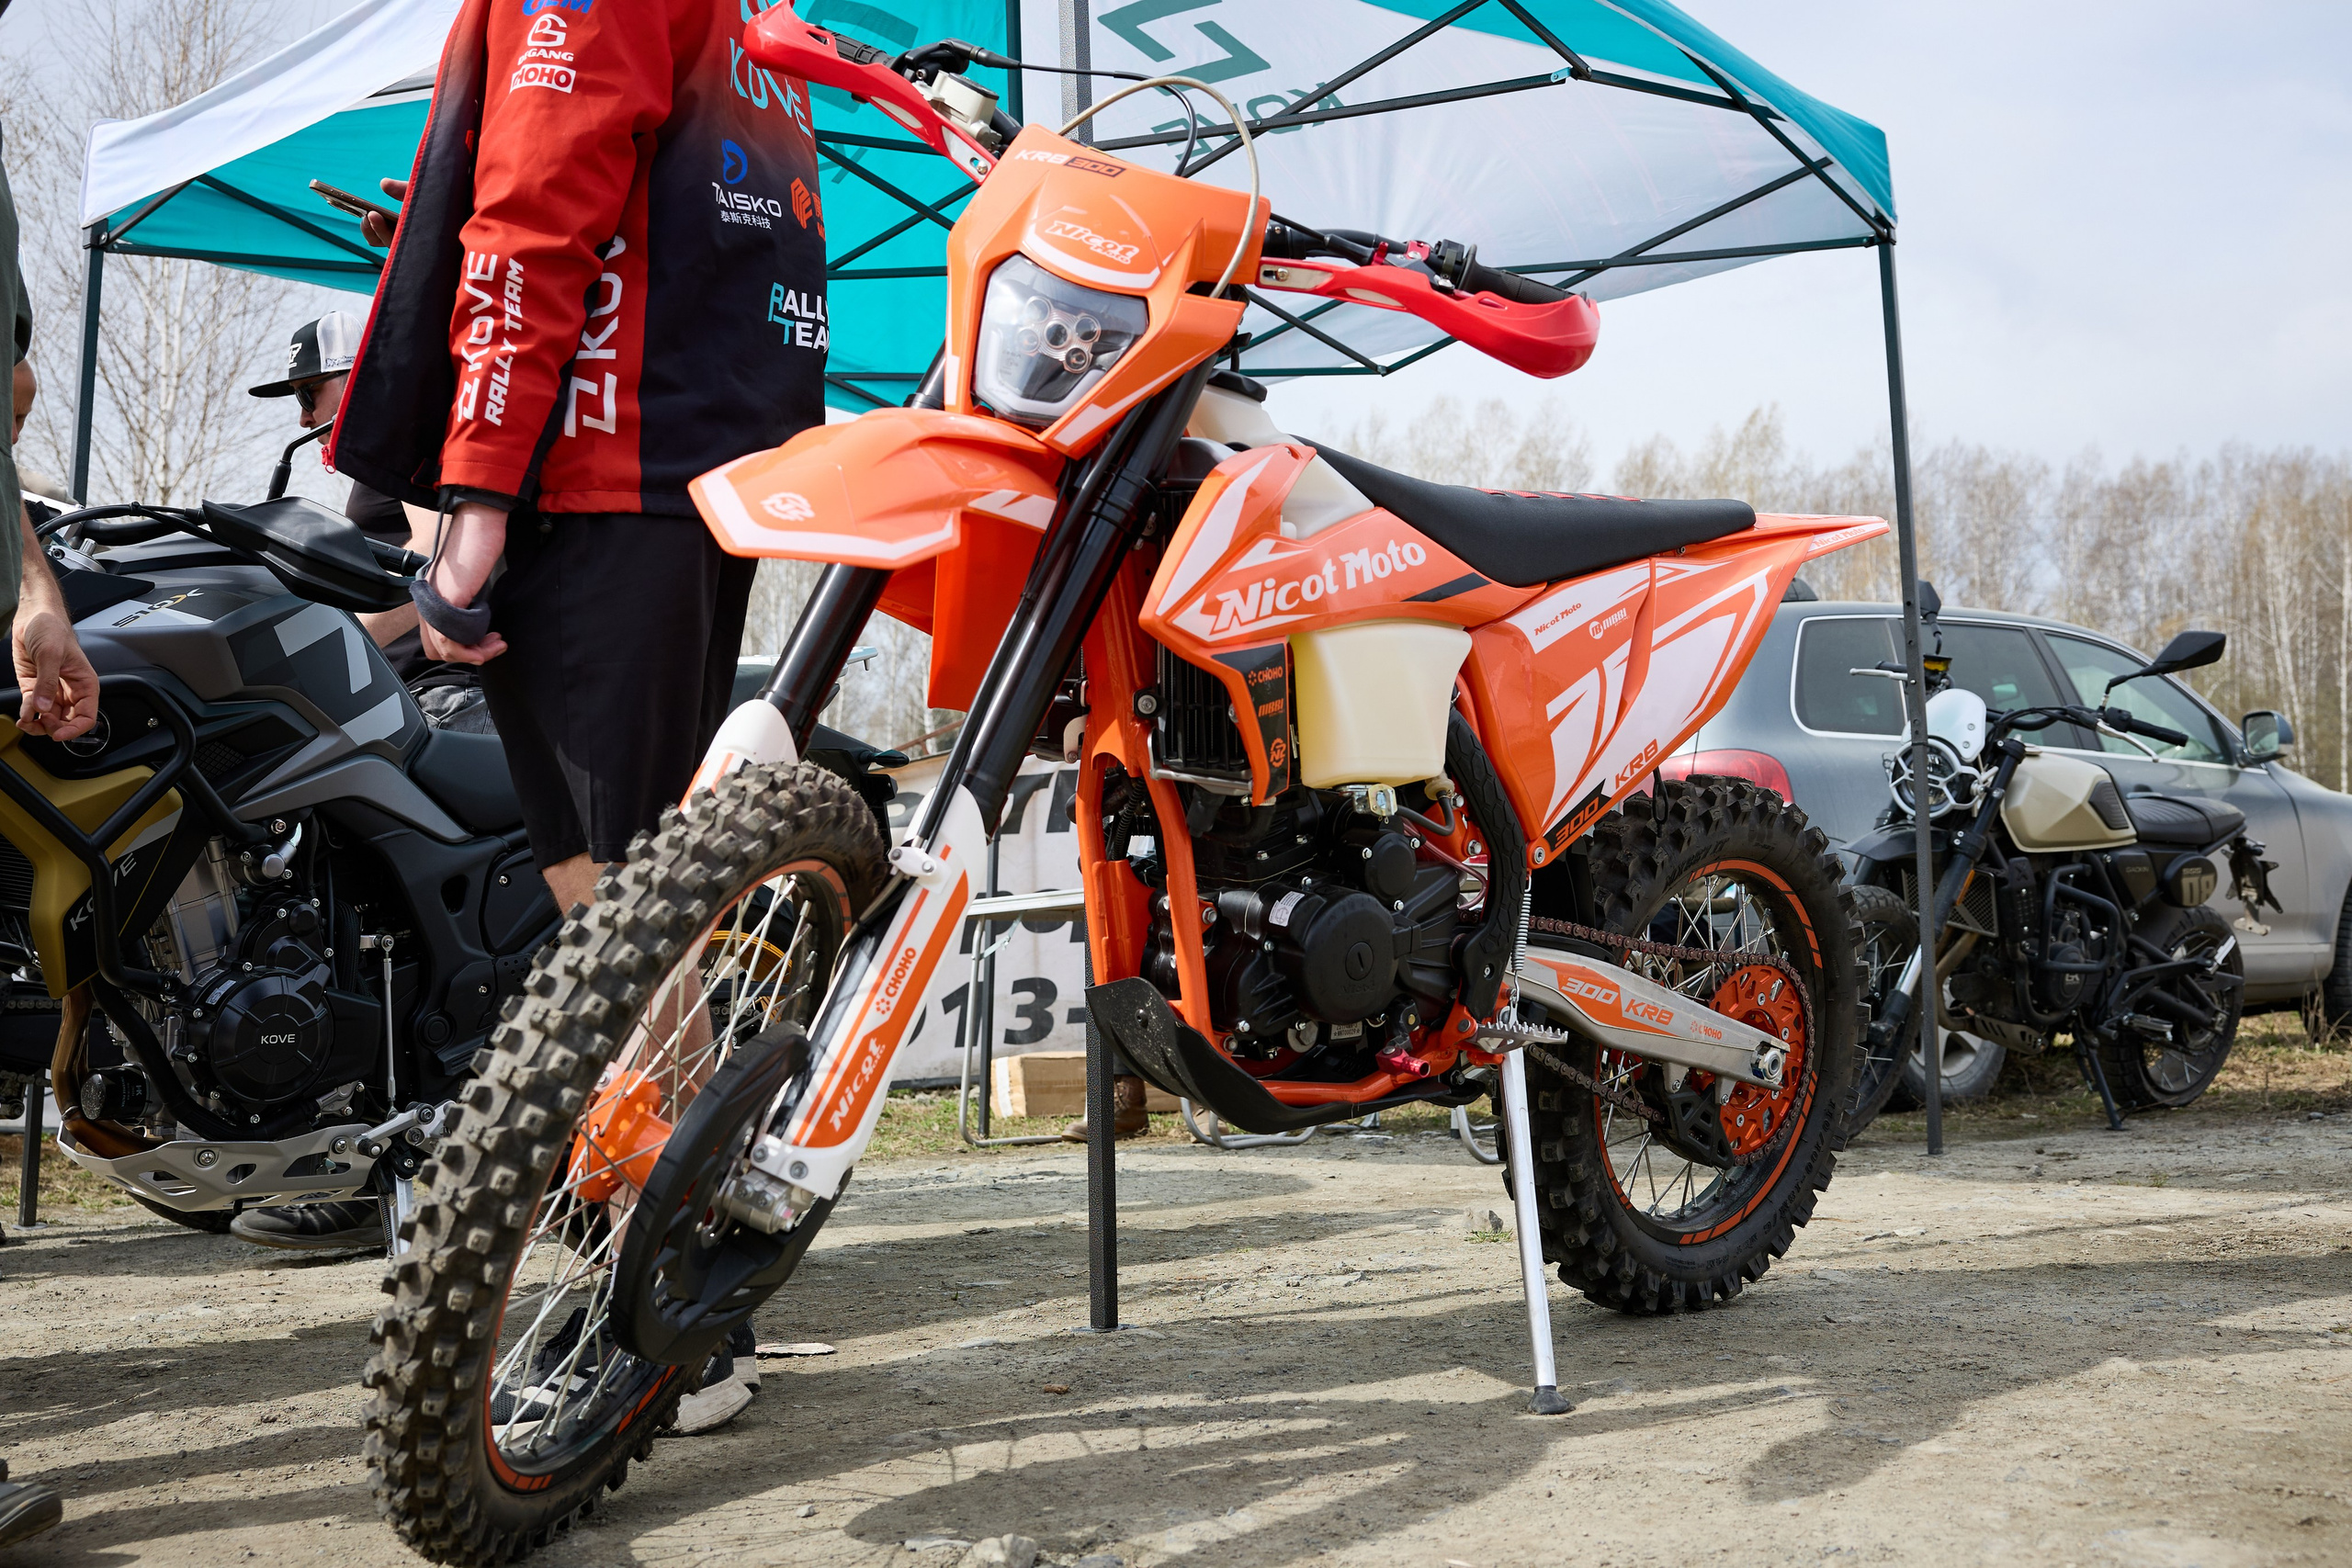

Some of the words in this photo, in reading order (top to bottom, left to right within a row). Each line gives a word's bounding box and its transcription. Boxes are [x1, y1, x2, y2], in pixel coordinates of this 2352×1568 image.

[1065, 156, 1125, 177] 300
[712, 182, 782, 218] TAISKO
[719, 210, 772, 230] 泰斯克科技
[1045, 220, 1139, 259] Nicot
[461, 251, 498, 373] KOVE
[484, 336, 518, 427] RALLY
[504, 257, 525, 332] TEAM
[773, 314, 830, 354] TEA
[1211, 558, 1340, 634] Nicot
[1340, 539, 1427, 591] Moto
[1534, 615, 1560, 636] Nicot
[1559, 603, 1582, 620] Moto
[1257, 665, 1283, 683] CHOHO
[1555, 796, 1600, 848] 300
[885, 947, 917, 998] CHOHO
[1561, 977, 1619, 1005] 300
[261, 1033, 296, 1044] KOVE
[829, 1037, 881, 1133] Nicot
